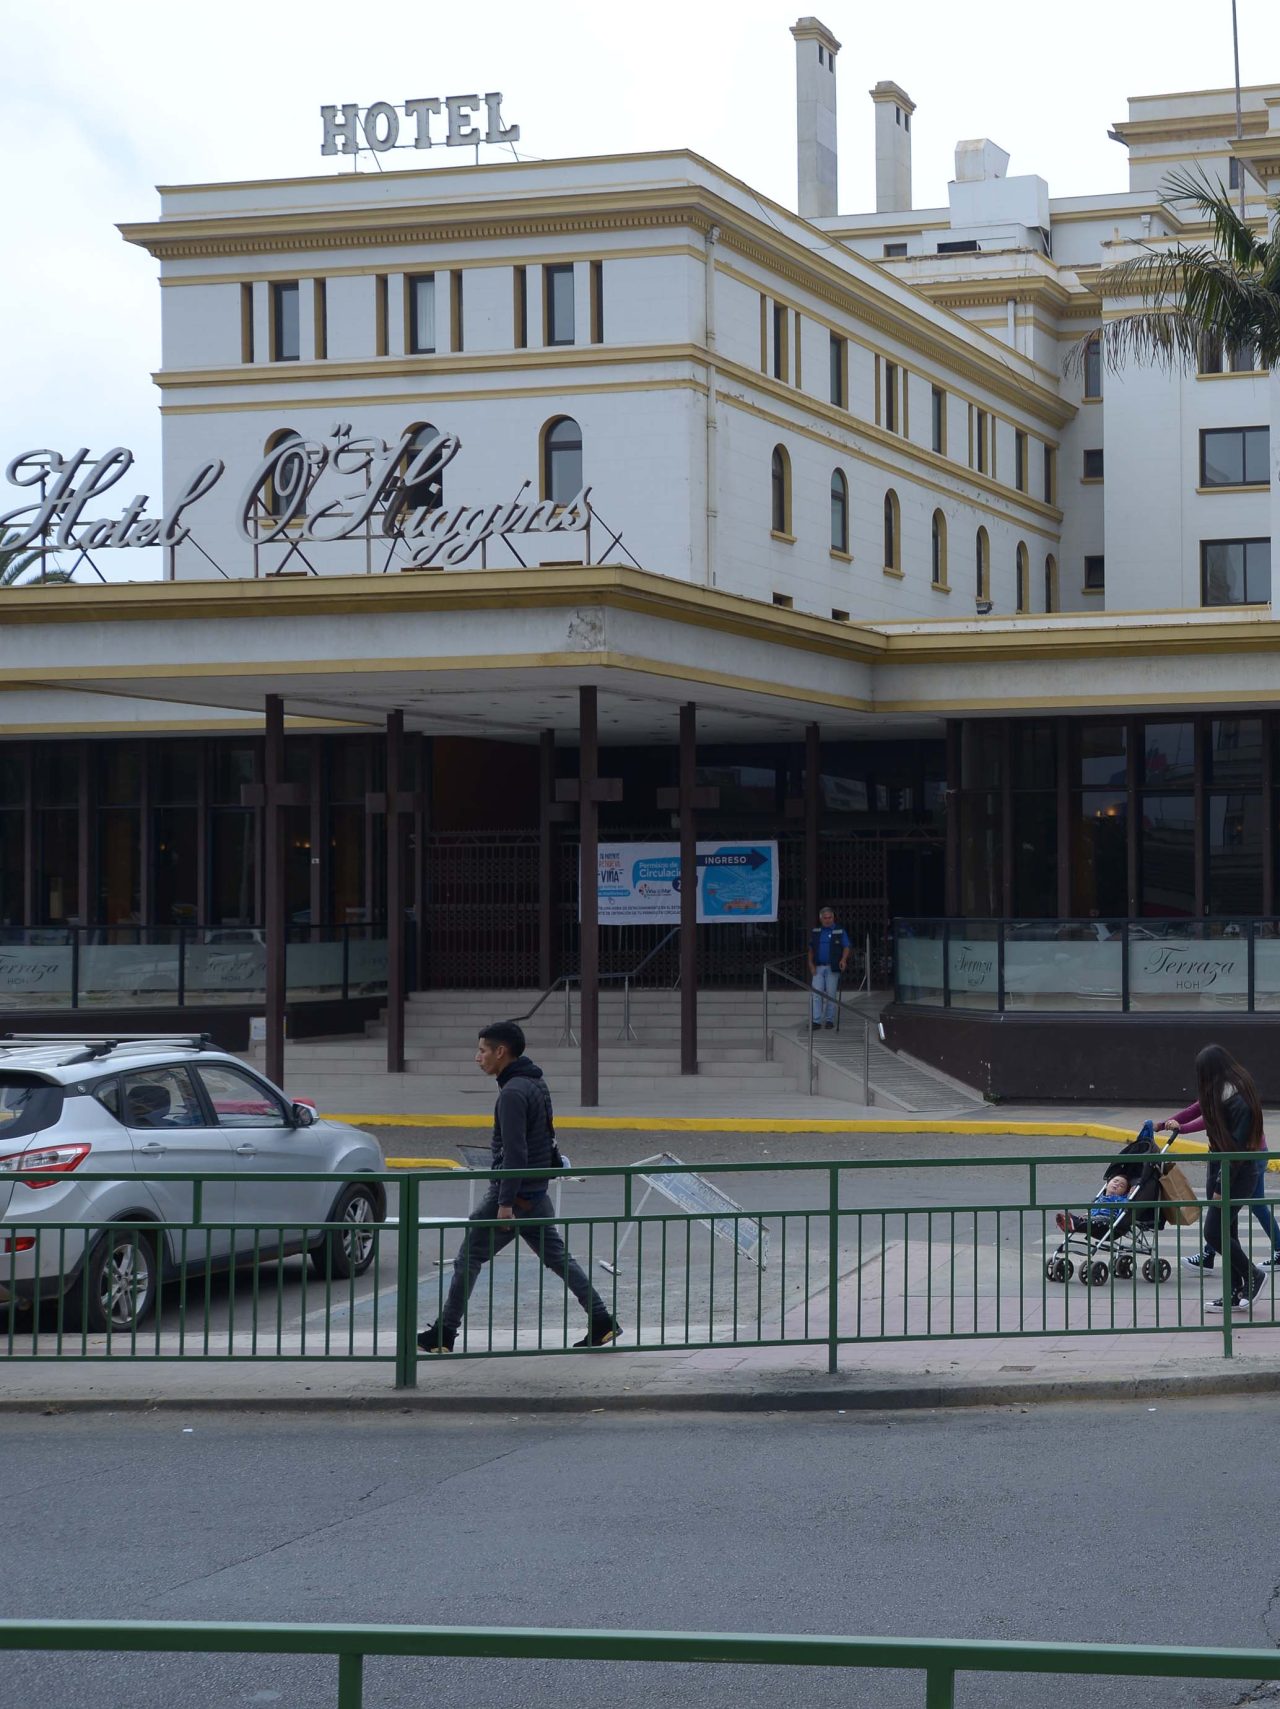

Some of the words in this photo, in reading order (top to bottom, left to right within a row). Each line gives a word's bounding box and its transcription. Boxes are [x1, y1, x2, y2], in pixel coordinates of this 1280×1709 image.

[320, 92, 520, 156] HOTEL
[0, 447, 224, 552] Hotel
[705, 856, 747, 864] INGRESO
[1144, 946, 1235, 987] Terraza
[1176, 980, 1200, 989] HOH
